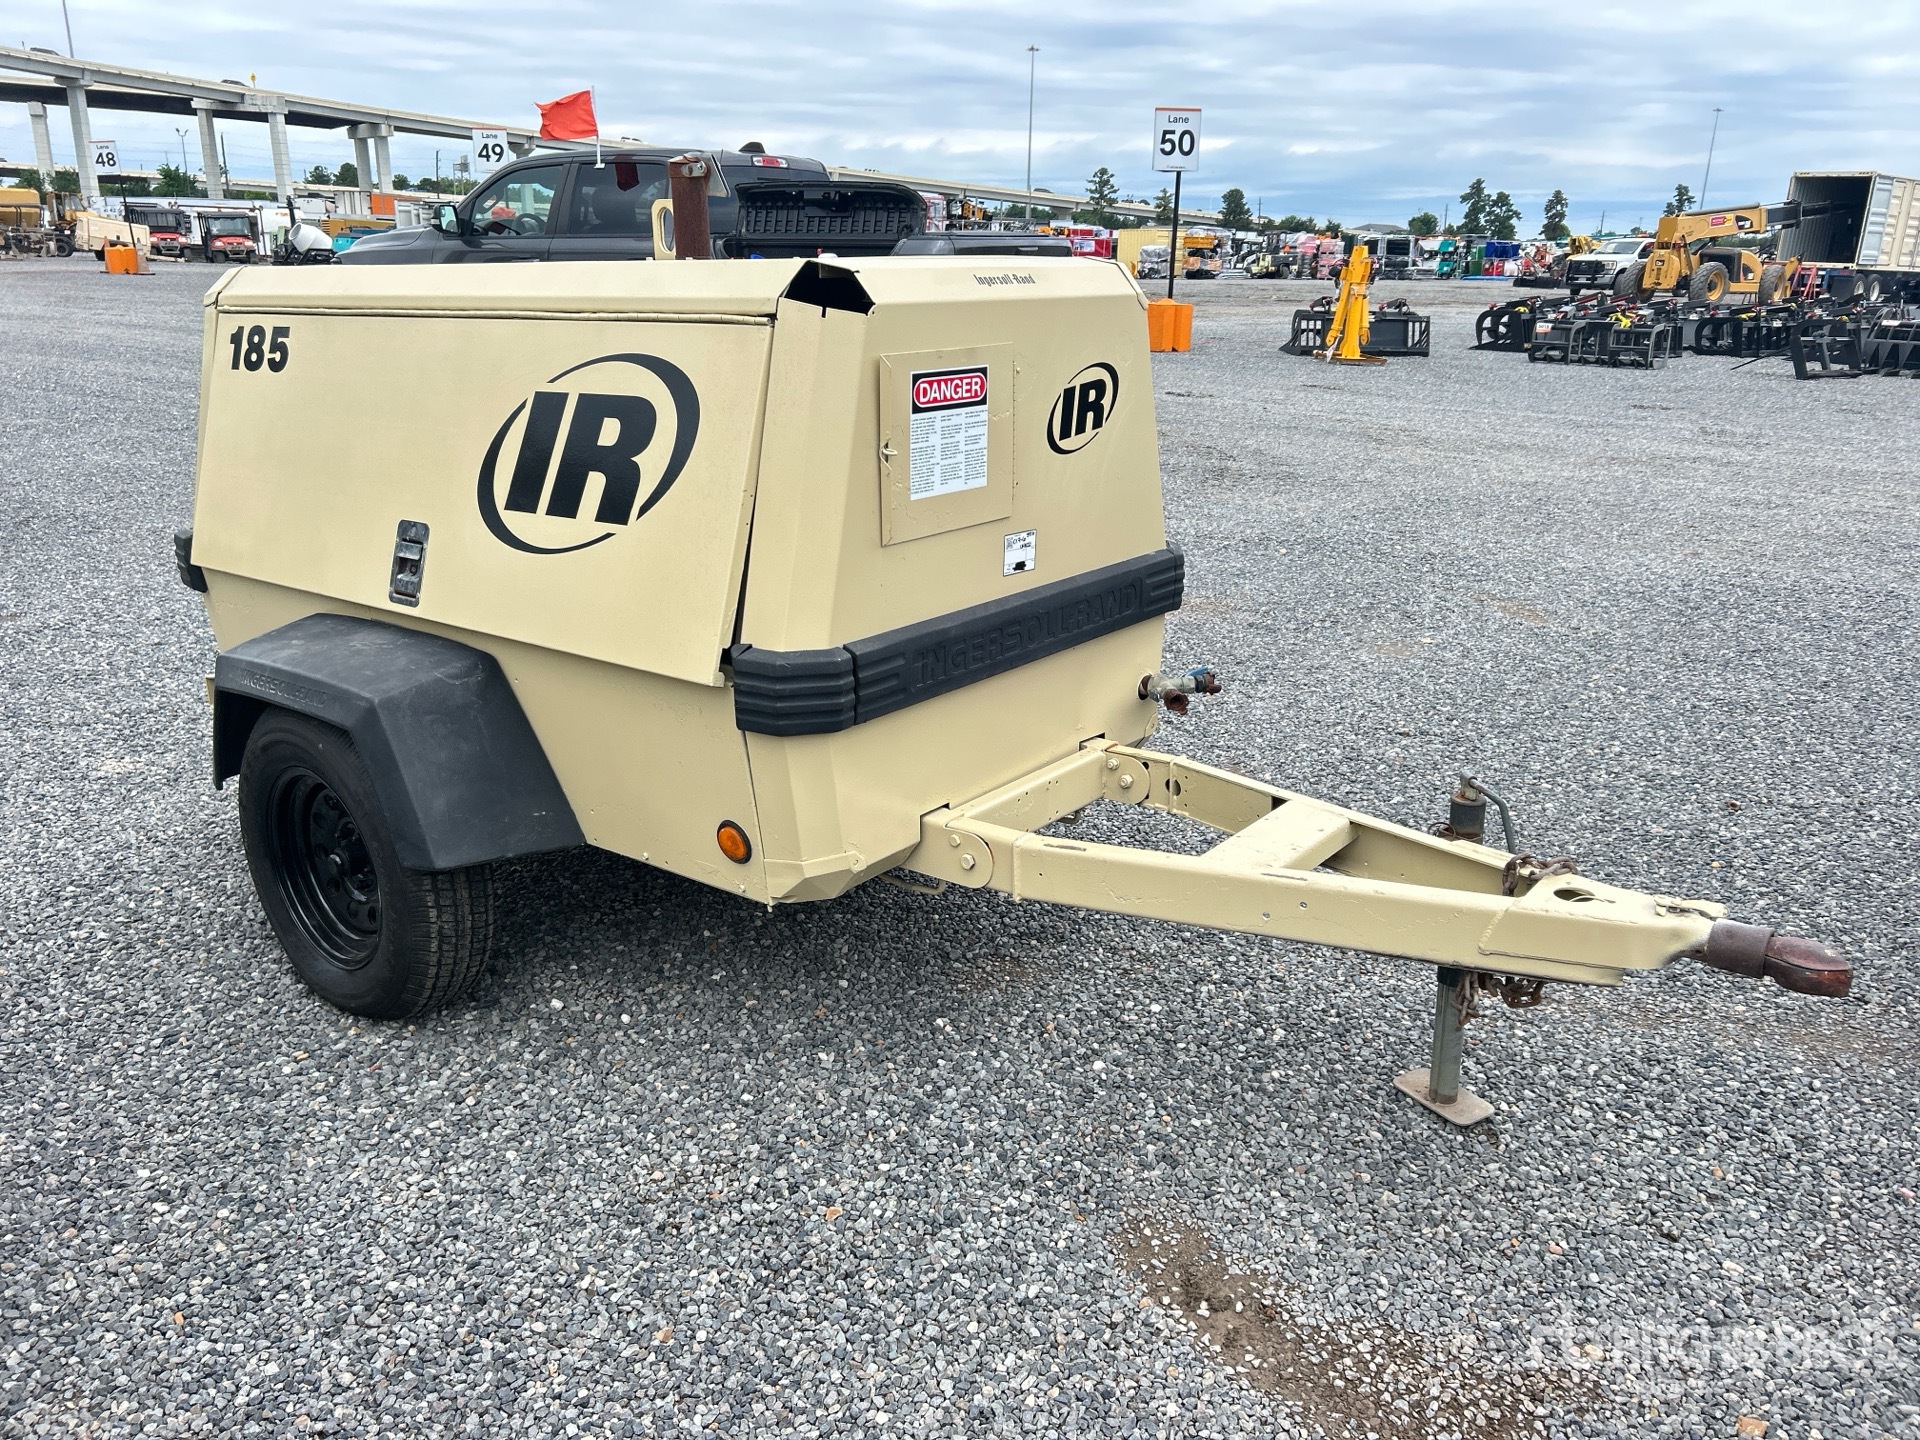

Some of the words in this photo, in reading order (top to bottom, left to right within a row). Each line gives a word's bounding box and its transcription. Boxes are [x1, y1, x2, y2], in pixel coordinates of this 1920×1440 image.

[1168, 114, 1190, 124] Lane
[477, 143, 505, 163] 49
[1159, 129, 1196, 157] 50
[95, 151, 117, 167] 48
[229, 324, 291, 374] 185
[919, 377, 982, 403] DANGER
[1058, 378, 1107, 442] IR
[503, 390, 658, 527] IR
